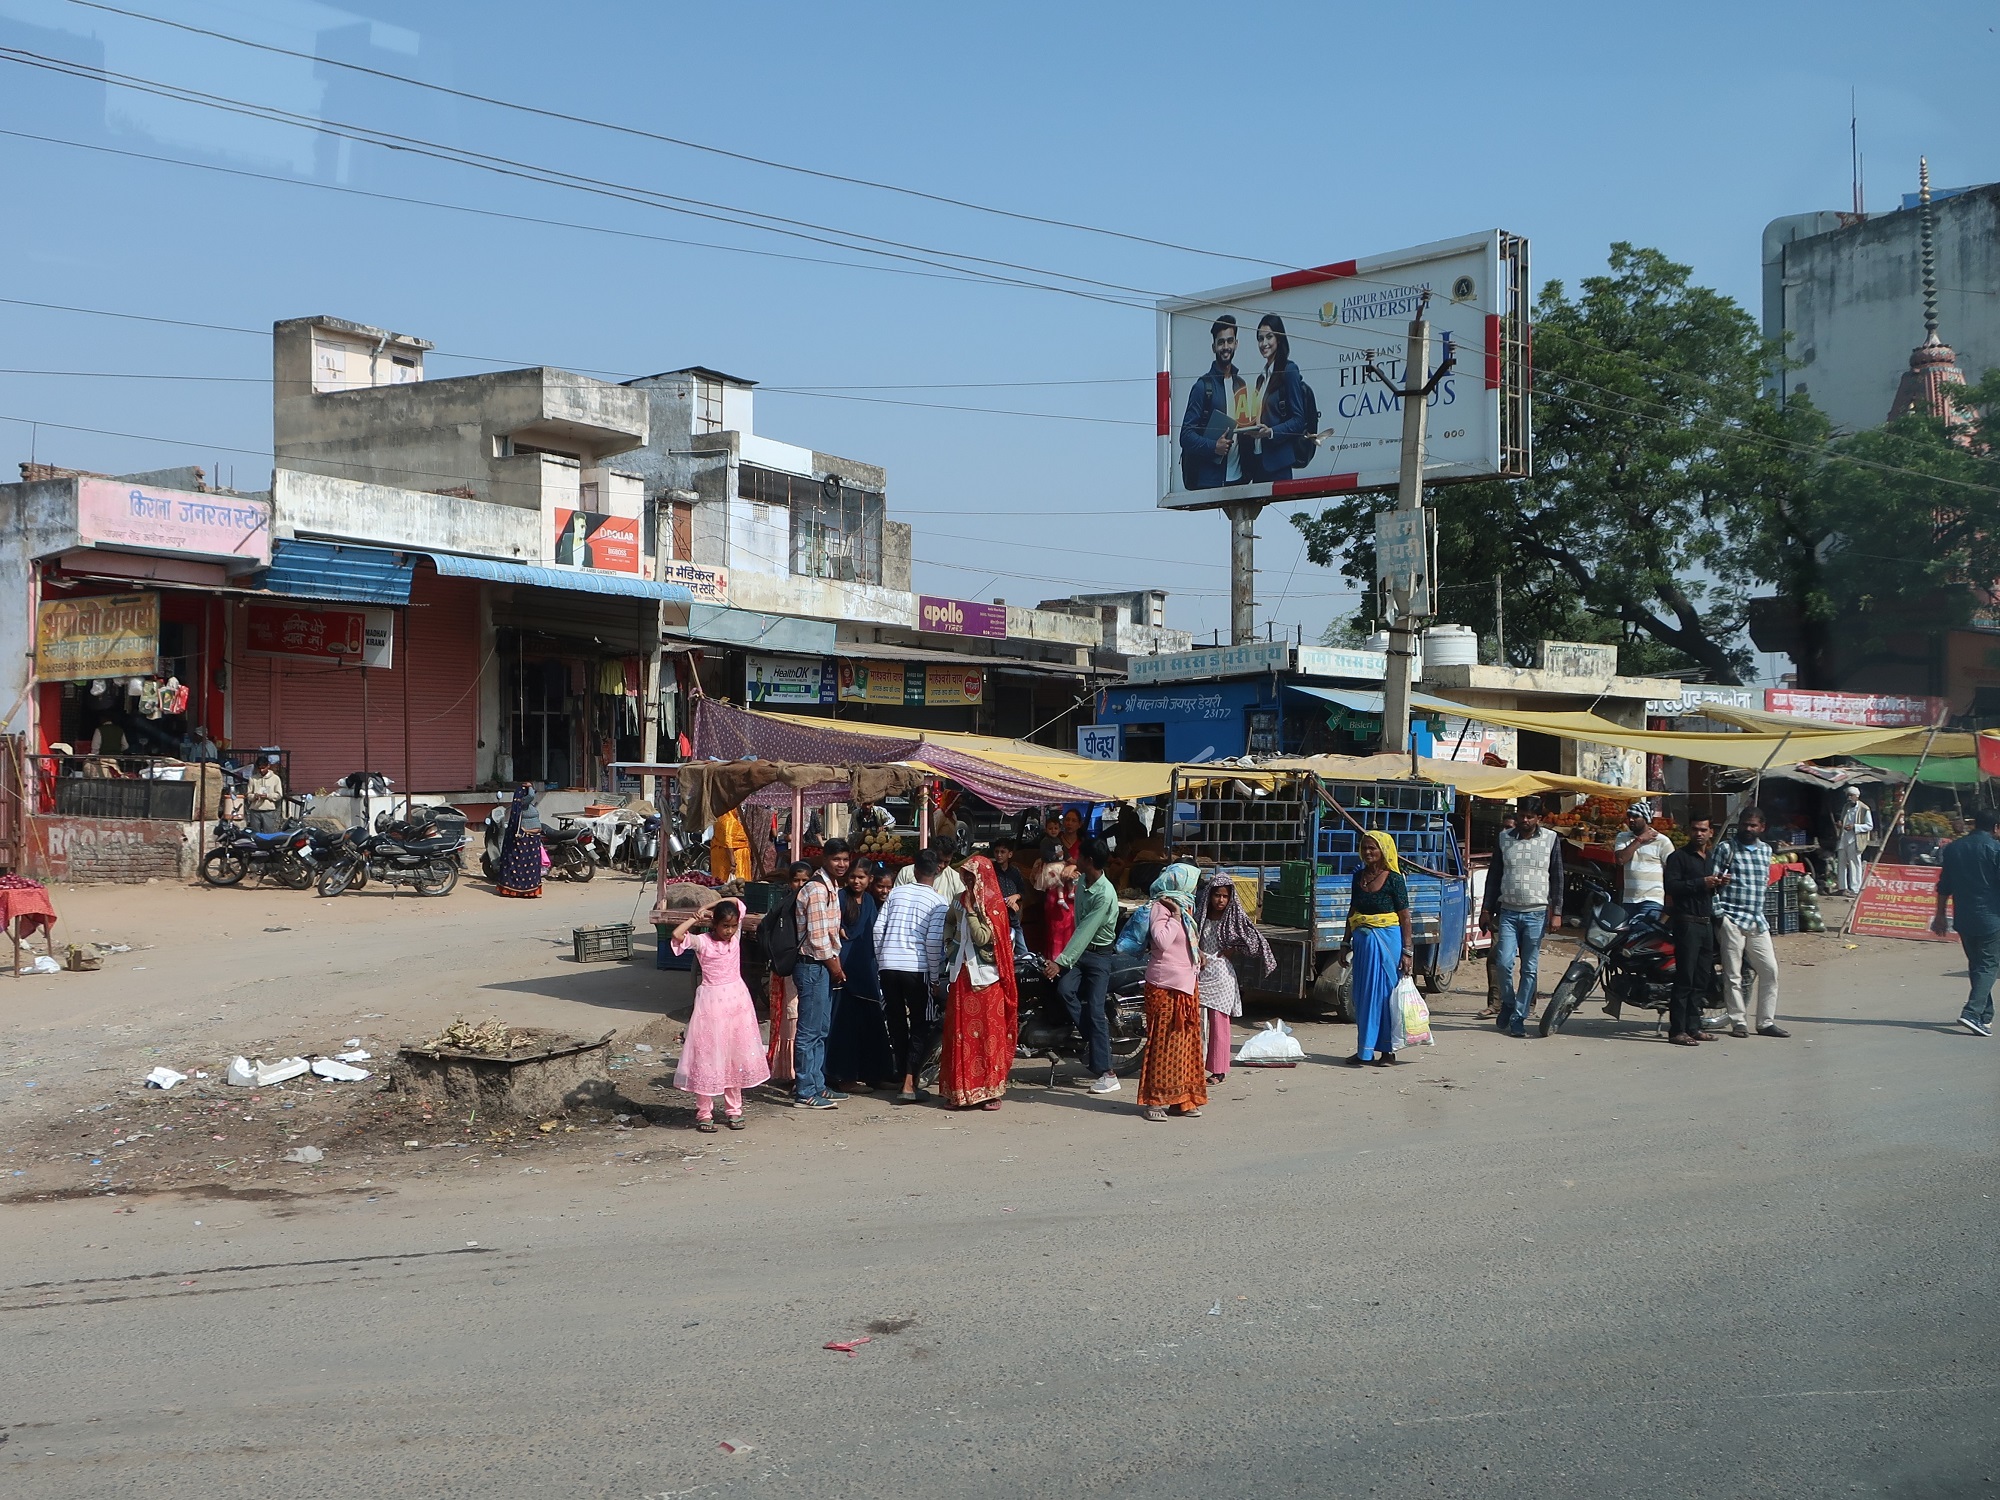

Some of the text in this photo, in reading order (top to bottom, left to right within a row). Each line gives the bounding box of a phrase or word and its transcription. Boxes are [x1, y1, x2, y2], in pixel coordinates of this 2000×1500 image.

[1342, 291, 1377, 309] JAIPUR
[1339, 344, 1402, 363] RAJASAN'S
[1339, 359, 1401, 388] FIRST
[1338, 379, 1456, 419] CAMUS
[178, 501, 231, 527] जनरल
[607, 529, 635, 542] DOLLAR
[924, 601, 964, 627] apollo
[365, 629, 387, 638] MADHAV
[944, 624, 963, 632] TYRES
[366, 638, 385, 647] KIRANA
[773, 667, 810, 679] HealthOK
[928, 670, 963, 685] माहेश्वरी चाय
[1125, 693, 1223, 713] श्री बालाजी जयपुर डेयरी
[1203, 708, 1232, 719] 23177
[1349, 720, 1373, 729] Bisleri
